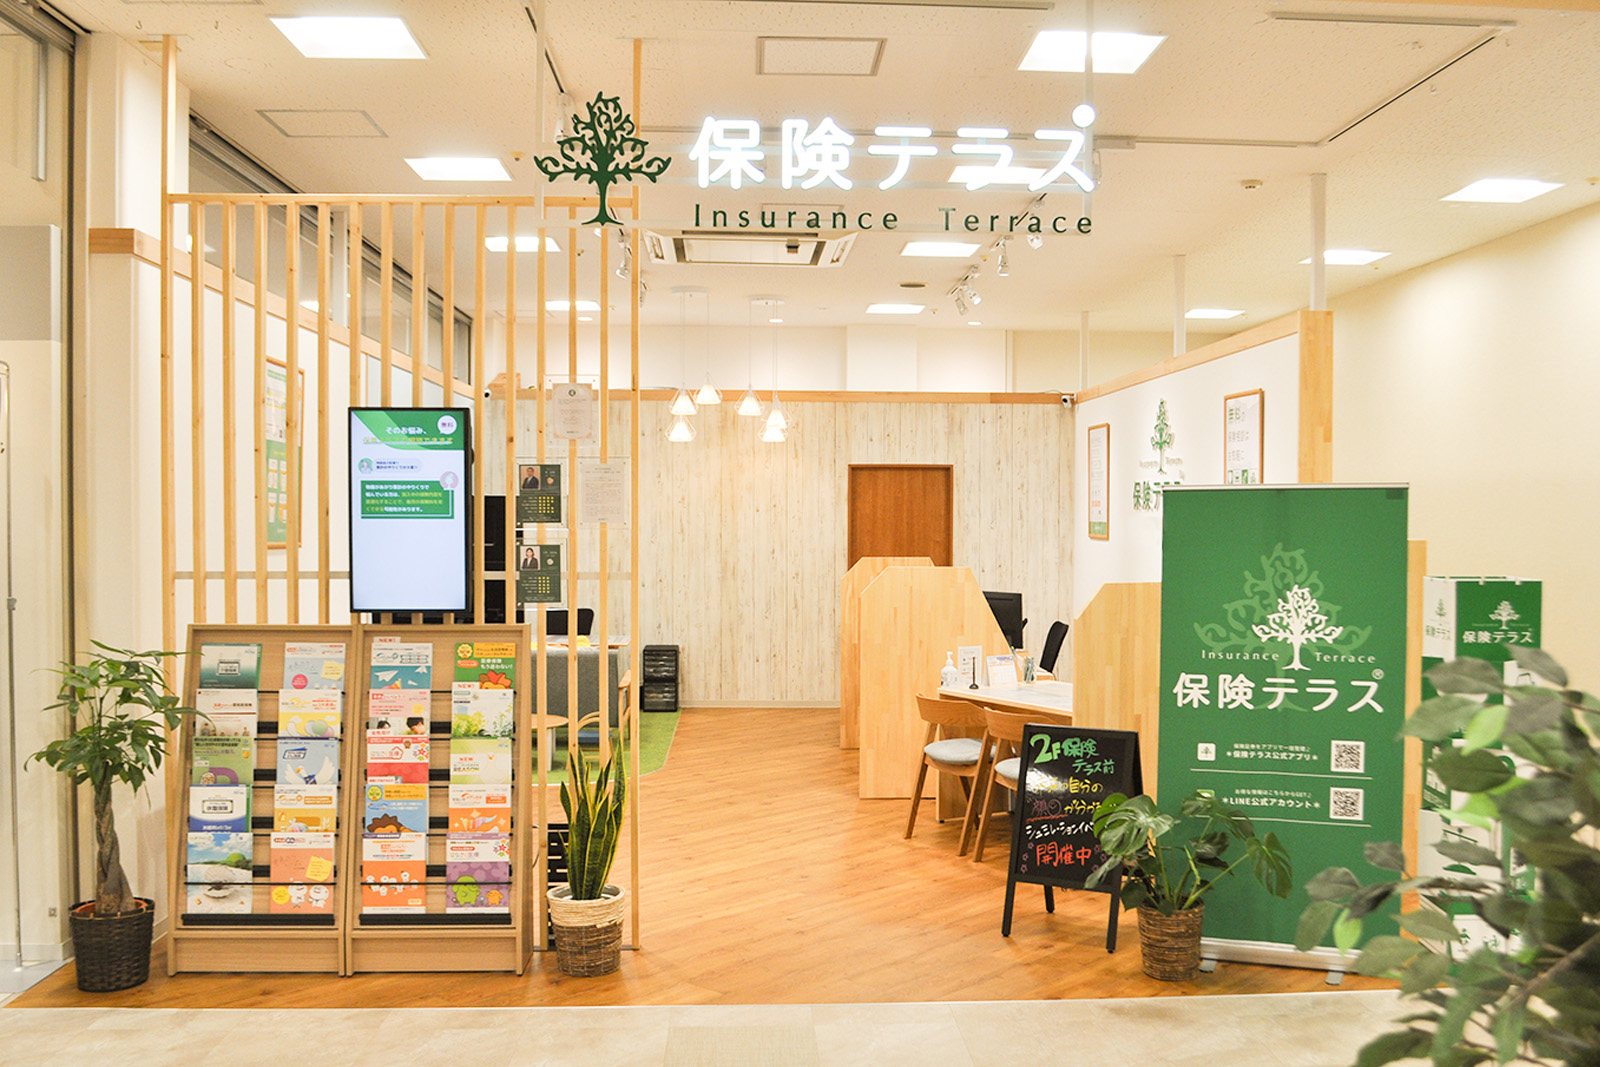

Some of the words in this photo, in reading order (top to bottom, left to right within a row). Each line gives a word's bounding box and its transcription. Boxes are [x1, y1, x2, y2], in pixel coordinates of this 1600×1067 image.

[688, 115, 1095, 193] 保険テラス
[694, 203, 899, 231] Insurance
[937, 207, 1094, 235] Terrace
[1462, 630, 1534, 644] 保険テラス
[1201, 649, 1280, 662] Insurance
[1314, 652, 1377, 664] Terrace
[1072, 759, 1115, 776] テラス前
[1036, 841, 1092, 867] 開催中
